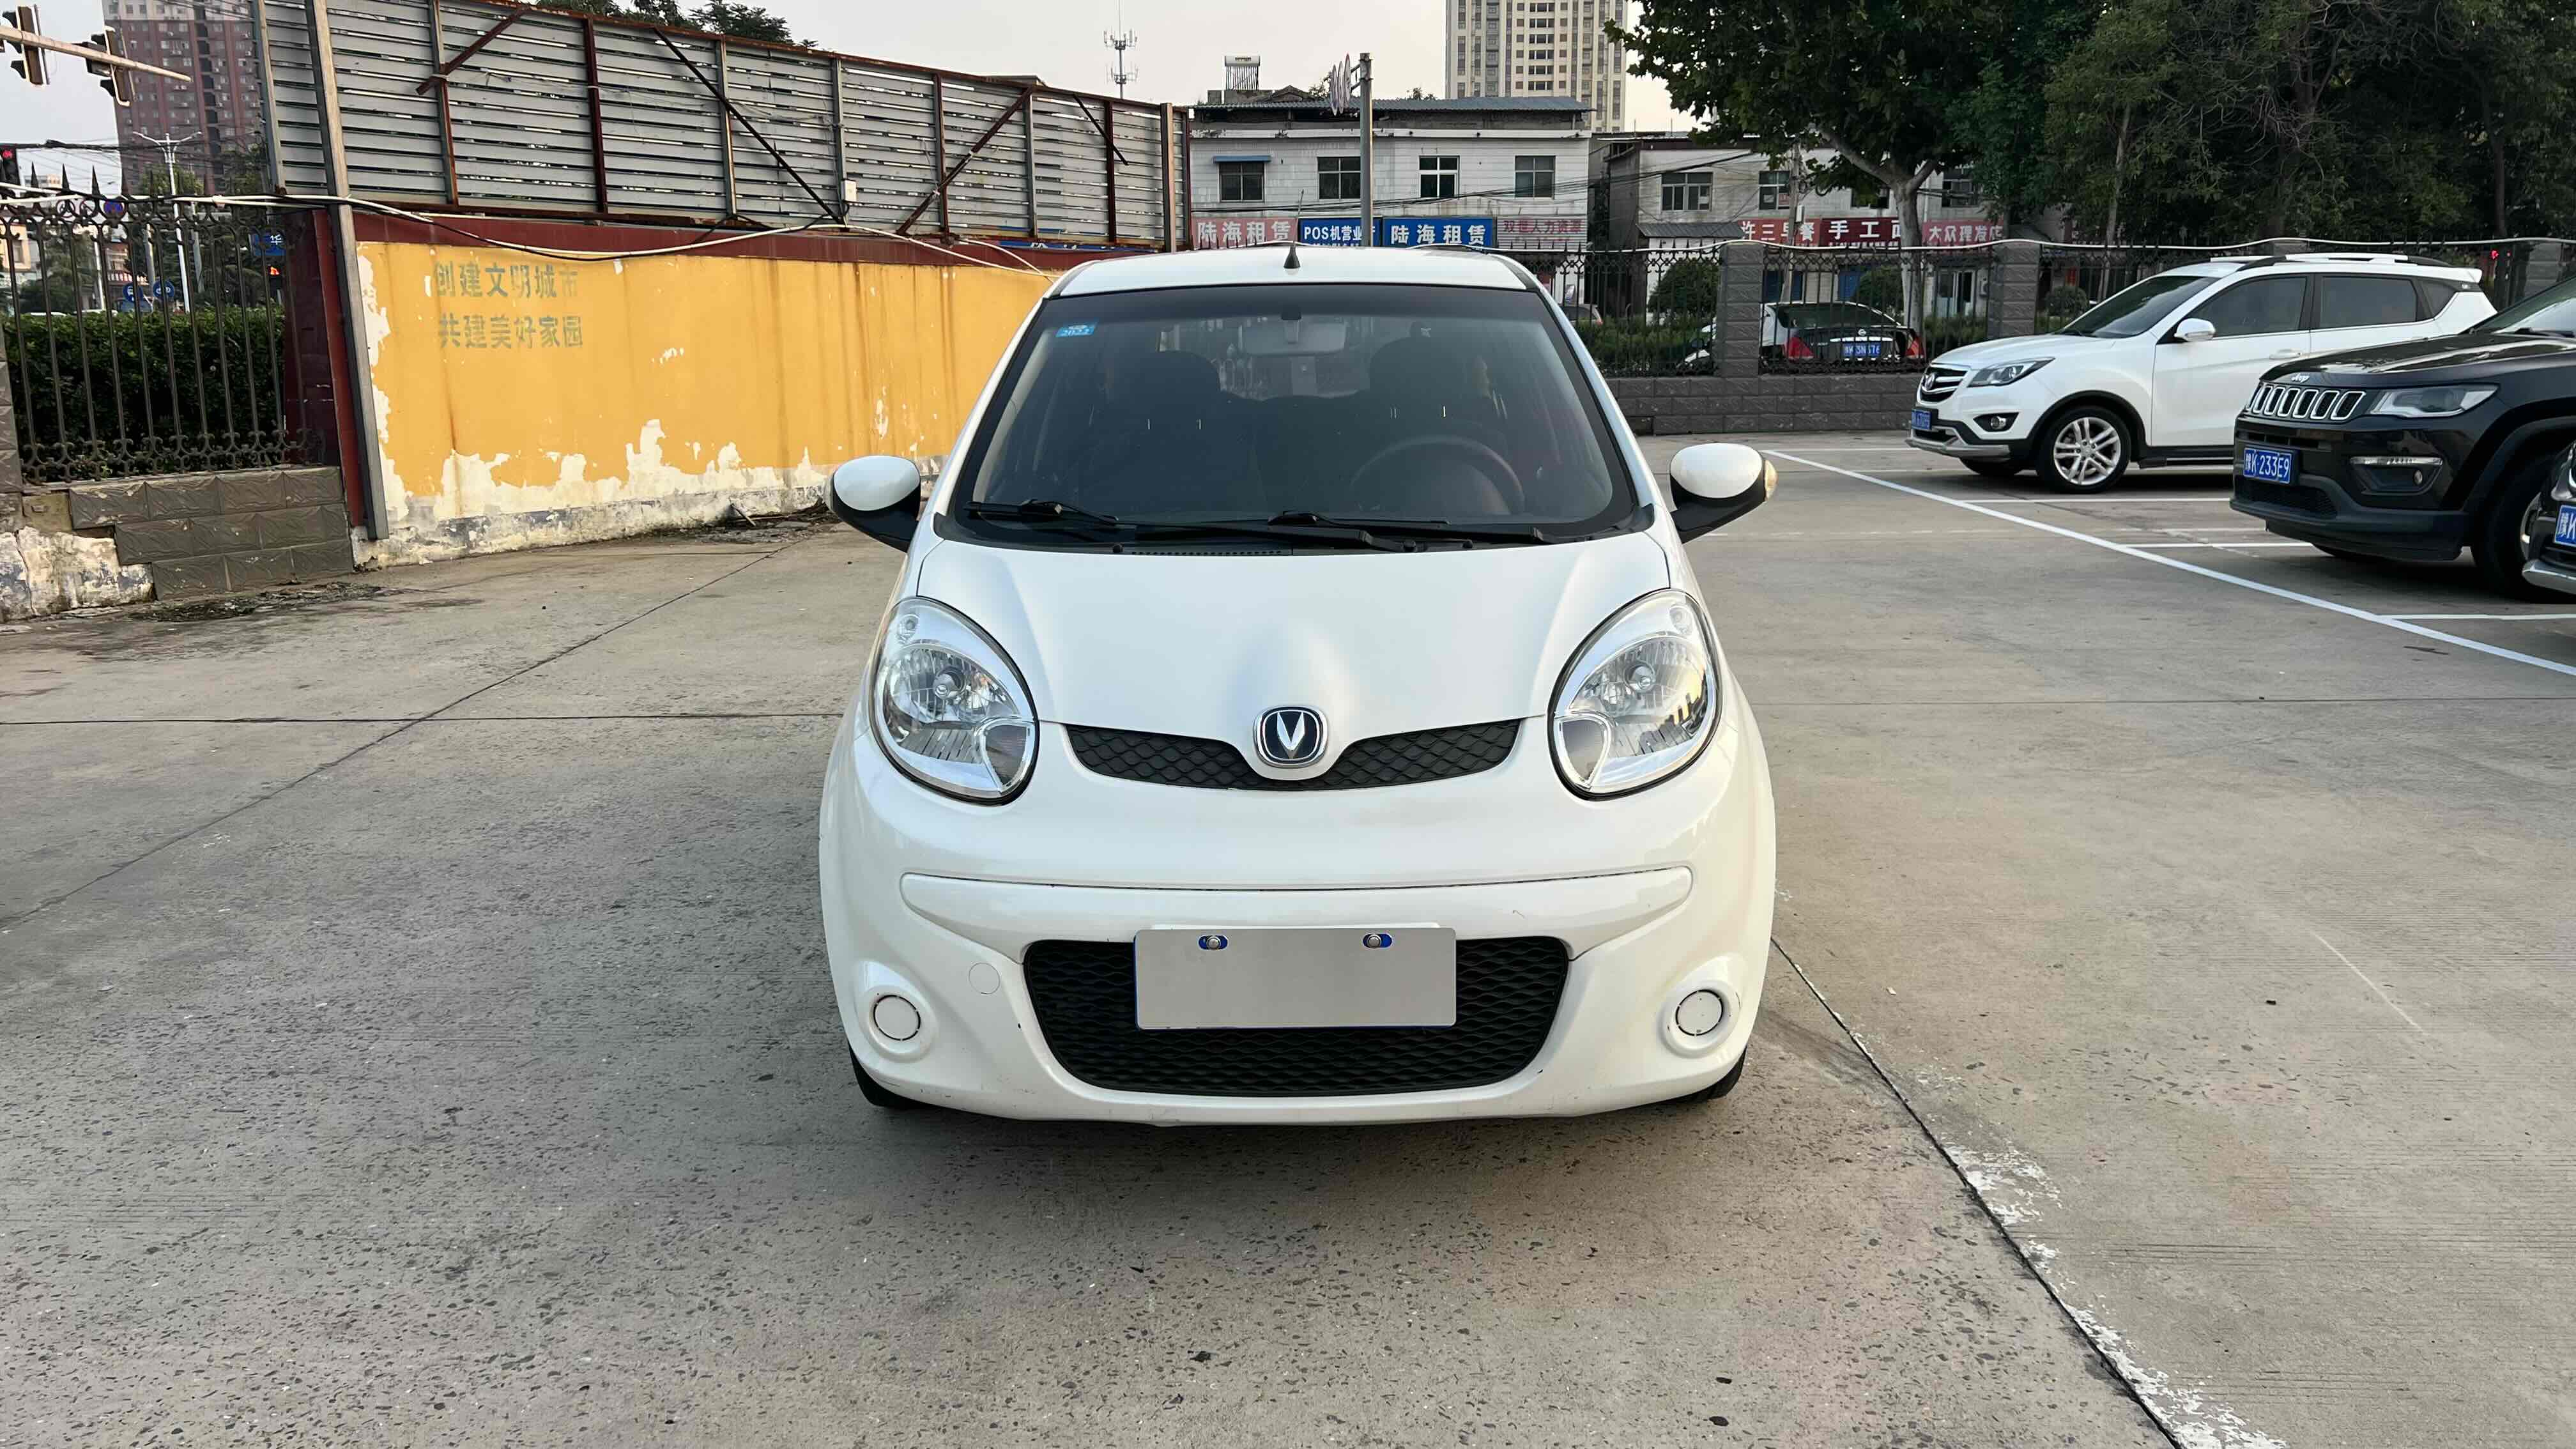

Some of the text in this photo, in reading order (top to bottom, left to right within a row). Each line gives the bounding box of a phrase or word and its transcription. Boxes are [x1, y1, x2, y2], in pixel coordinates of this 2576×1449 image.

[1197, 220, 1291, 244] 陆海租赁
[1390, 224, 1486, 245] 陆海租赁
[434, 260, 578, 298] 创建文明城市
[438, 312, 583, 349] 共建美好家园
